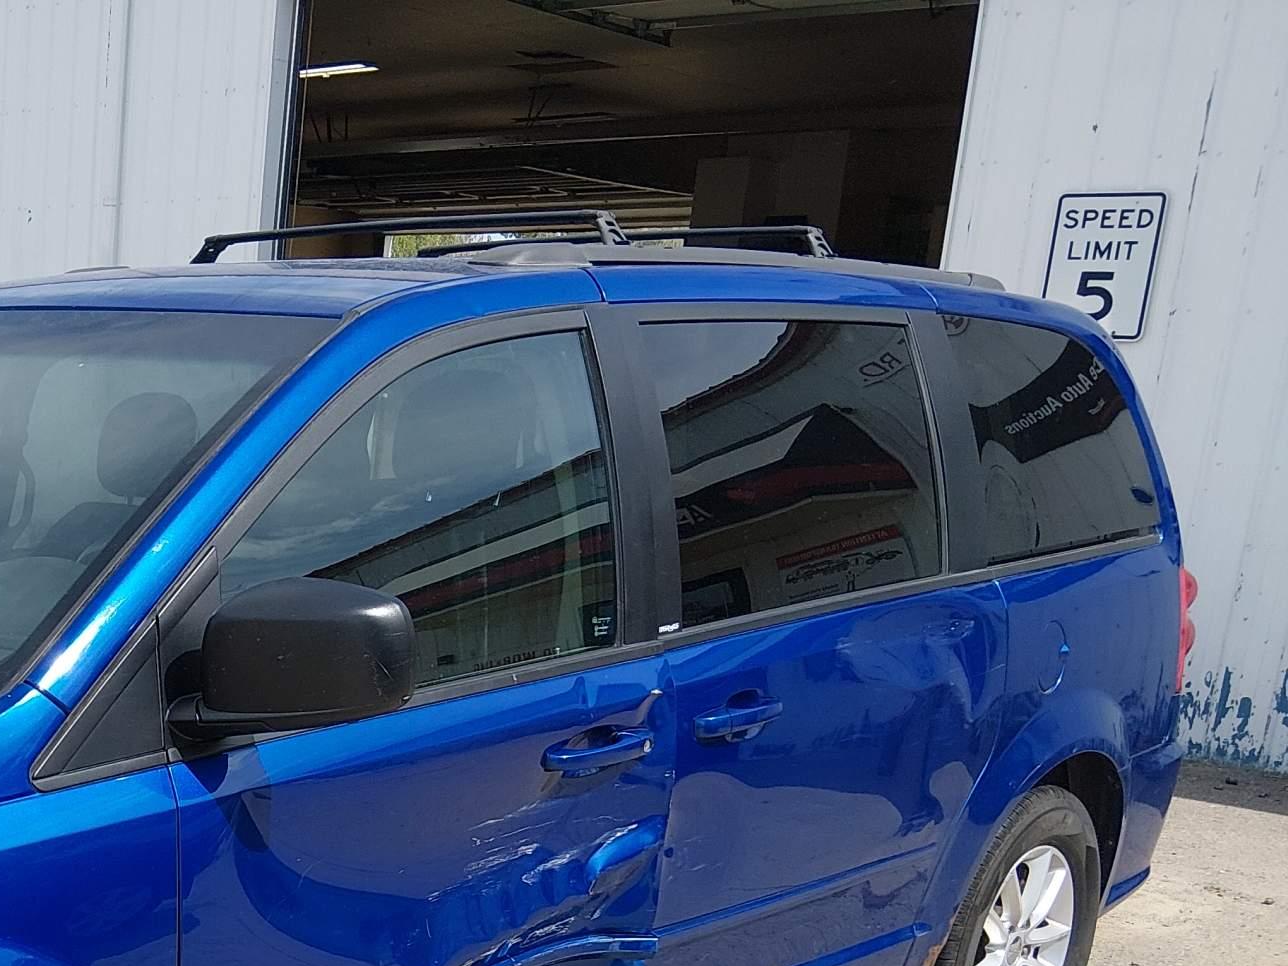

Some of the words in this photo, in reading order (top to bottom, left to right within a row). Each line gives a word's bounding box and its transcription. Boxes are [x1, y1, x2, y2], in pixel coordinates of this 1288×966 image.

[1063, 209, 1154, 229] SPEED
[1067, 241, 1139, 261] LIMIT
[1077, 271, 1115, 321] 5
